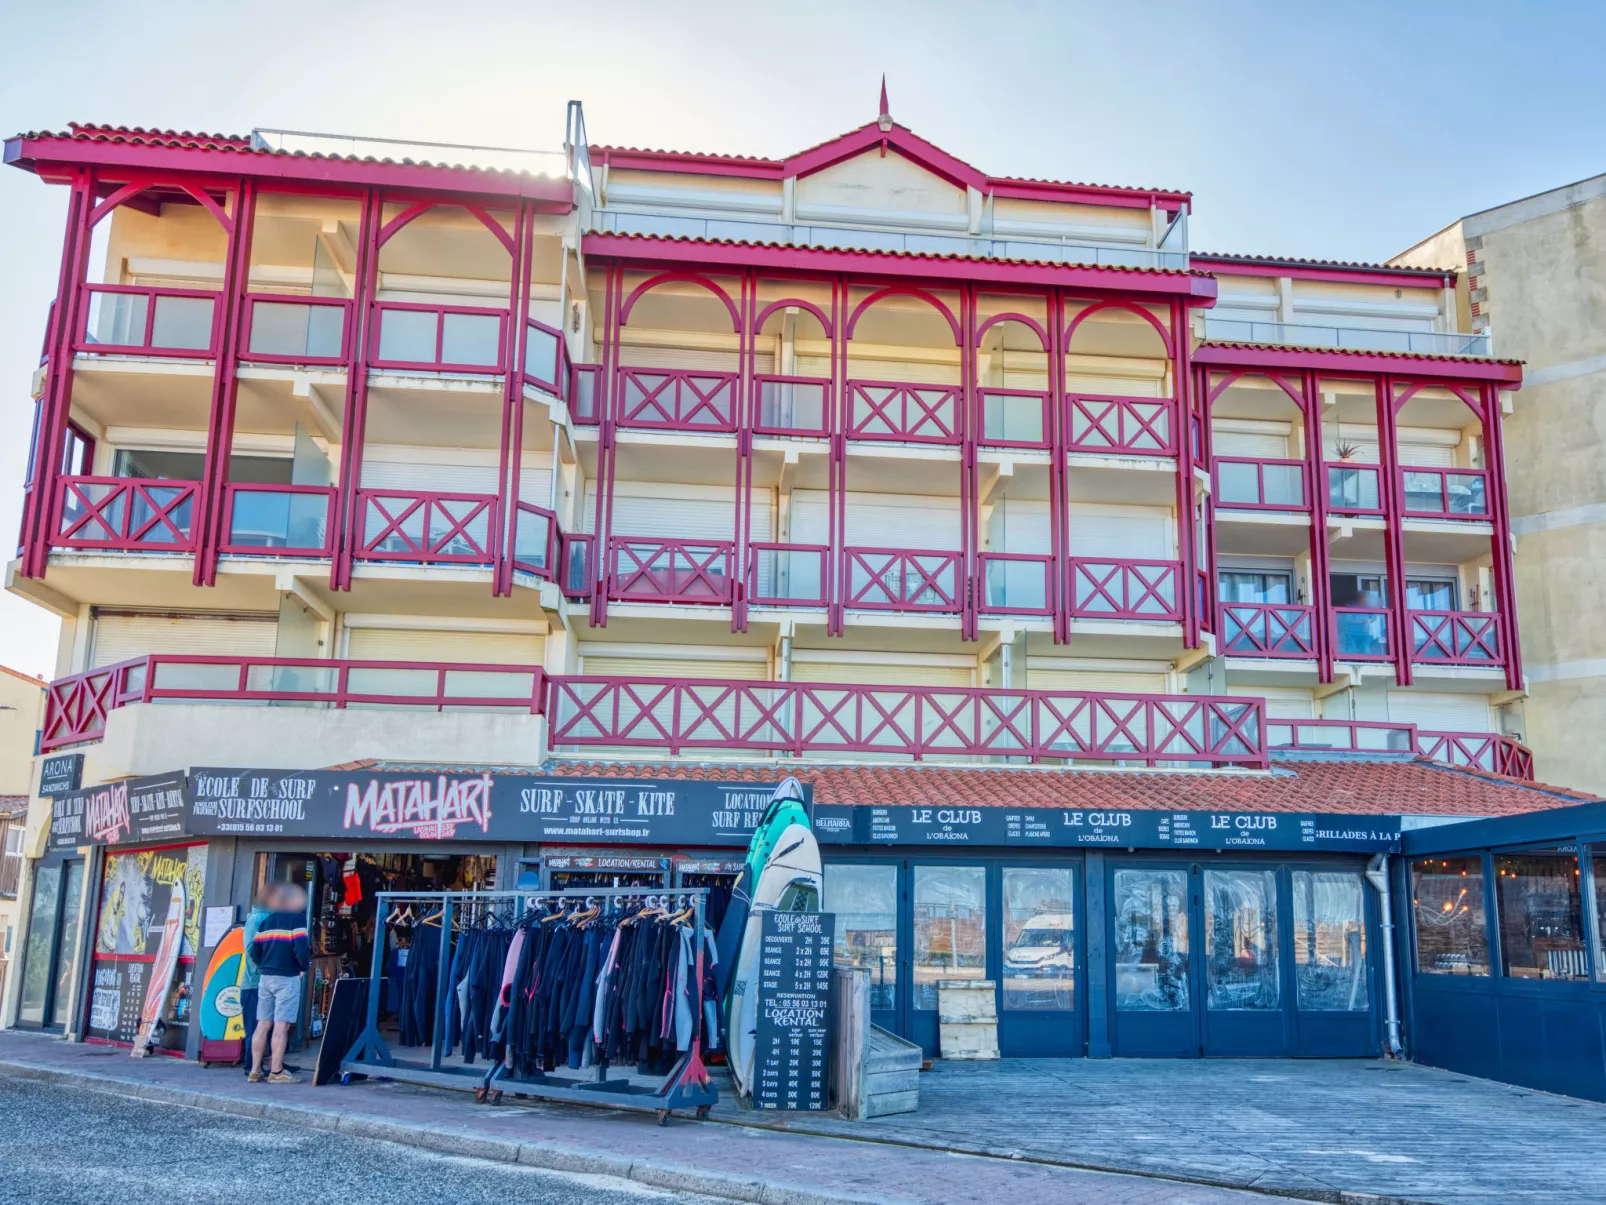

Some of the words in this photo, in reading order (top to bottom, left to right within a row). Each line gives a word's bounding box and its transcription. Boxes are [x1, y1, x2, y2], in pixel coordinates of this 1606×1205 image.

[44, 758, 72, 776] ARONA
[250, 778, 269, 798] DE
[279, 779, 316, 799] SURF
[344, 774, 494, 839] MATAHARI
[520, 789, 563, 813] SURF
[575, 790, 625, 814] SKATE
[637, 792, 675, 815] KITE
[218, 799, 305, 820] SURFSCHOOL
[712, 812, 741, 827] SURF
[912, 810, 932, 823] LE
[938, 810, 982, 824] CLUB
[1064, 812, 1083, 826] LE
[1089, 813, 1131, 826] CLUB
[1211, 816, 1230, 828] LE
[1235, 816, 1277, 829] CLUB
[544, 827, 650, 837] www.matahari-surfshop.fr
[1370, 831, 1377, 840] À
[801, 915, 820, 924] SURF
[778, 923, 795, 933] SURF
[798, 924, 822, 933] SCHOOL
[765, 1009, 824, 1018] LOCATION
[774, 1018, 819, 1026] RENTAL
